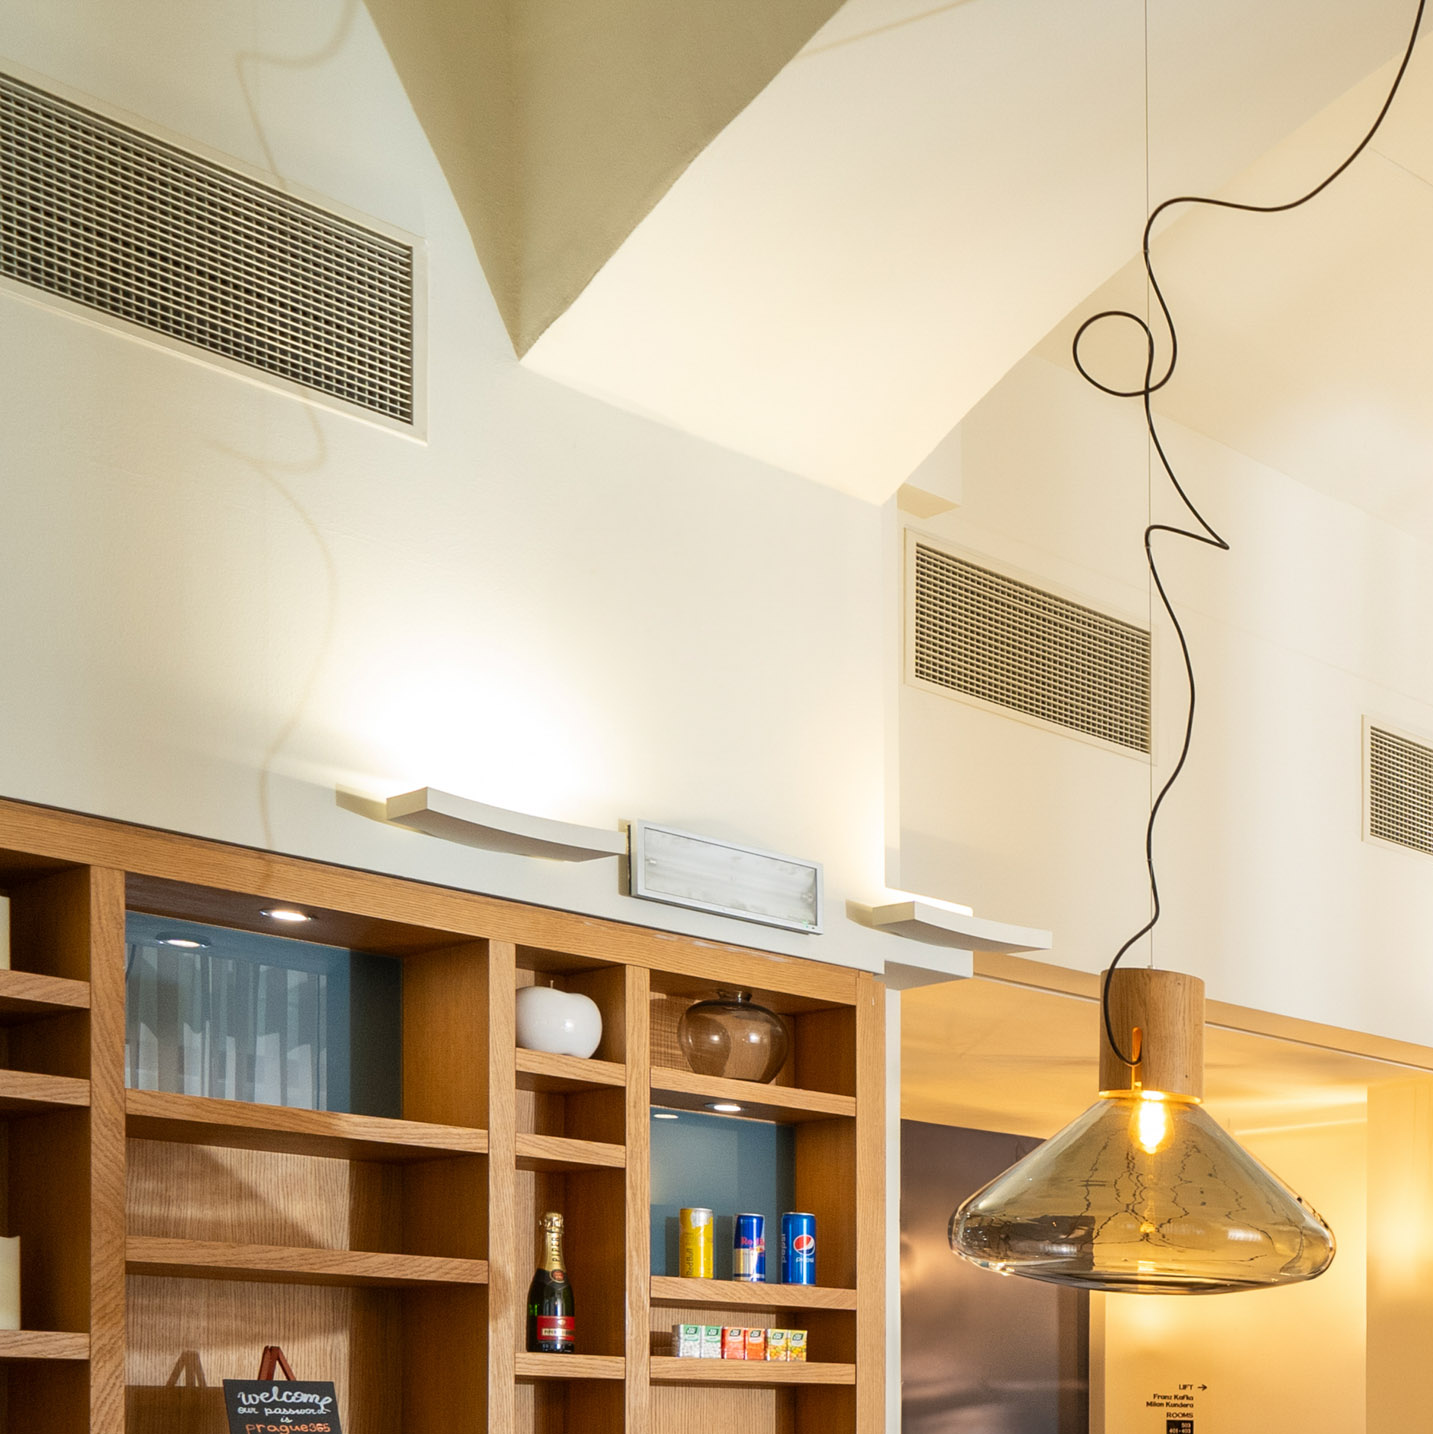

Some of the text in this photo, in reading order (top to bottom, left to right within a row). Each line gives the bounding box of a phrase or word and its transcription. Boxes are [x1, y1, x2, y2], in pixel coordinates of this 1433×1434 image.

[237, 1386, 333, 1407] welcome
[237, 1406, 331, 1416] our password
